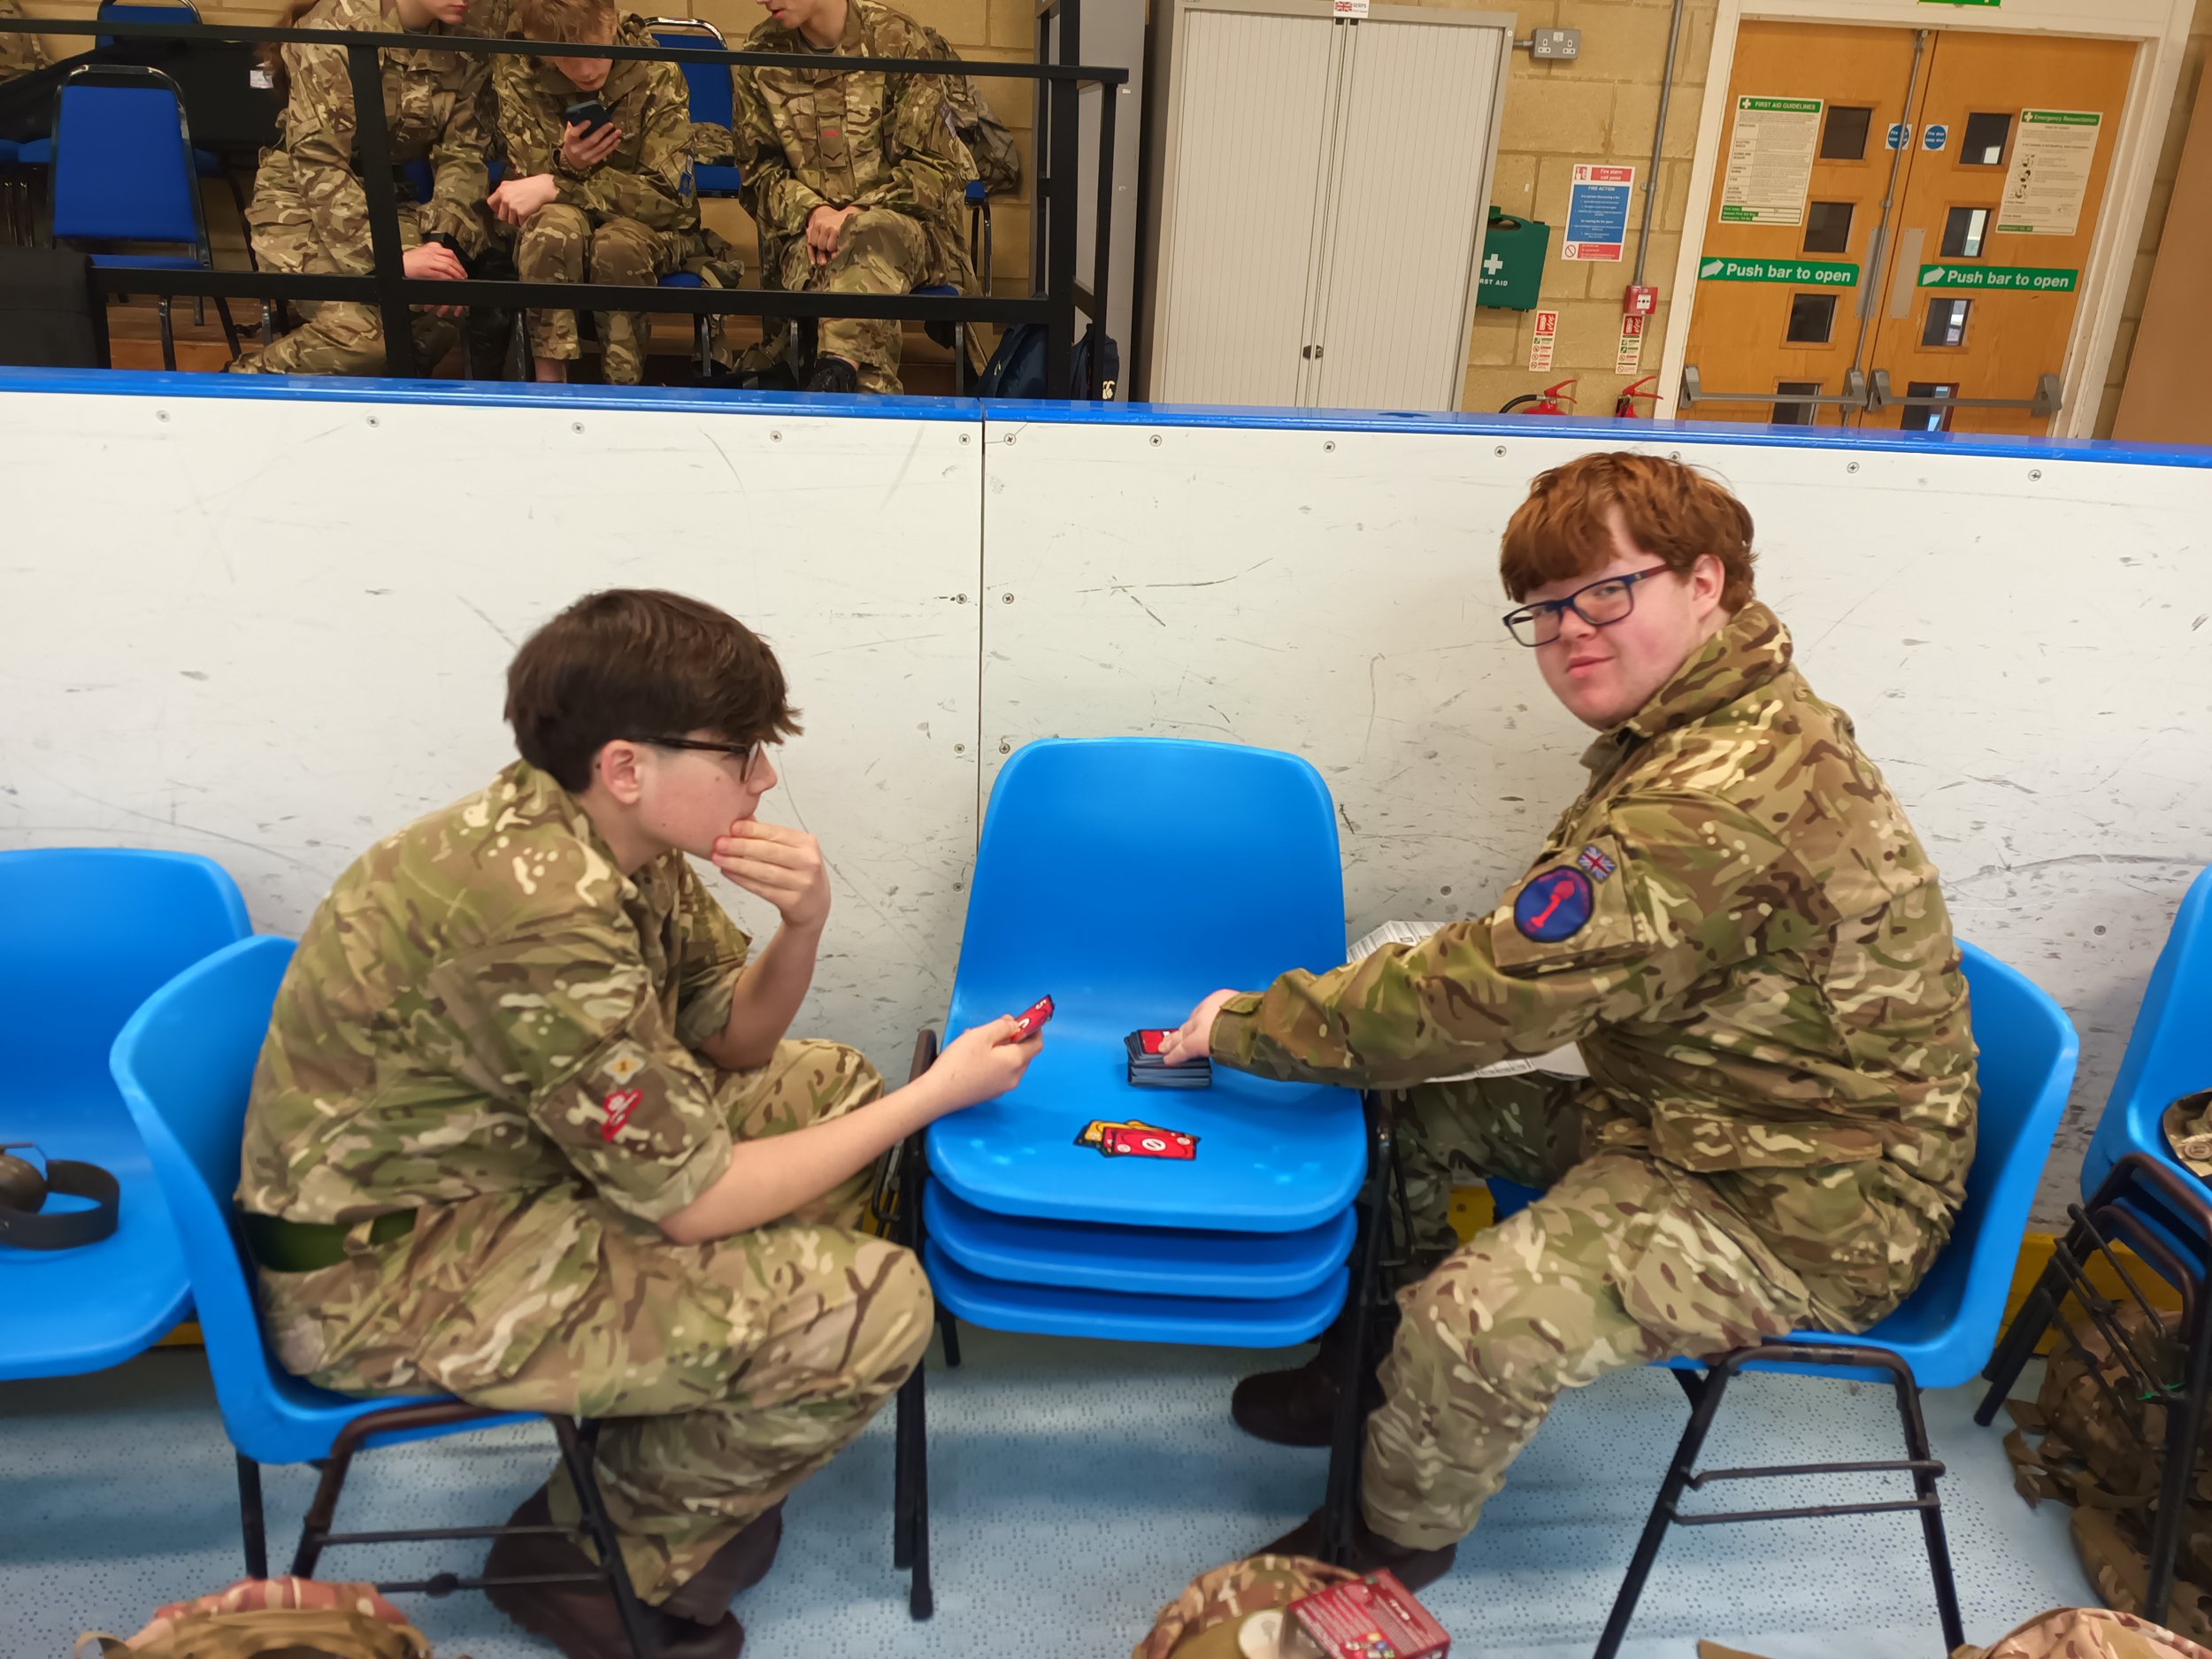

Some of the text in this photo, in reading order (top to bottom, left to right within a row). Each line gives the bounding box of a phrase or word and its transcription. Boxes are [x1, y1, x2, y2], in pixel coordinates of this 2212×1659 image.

[1726, 263, 1851, 283] Push bar to open
[1947, 270, 2070, 288] Push bar to open
